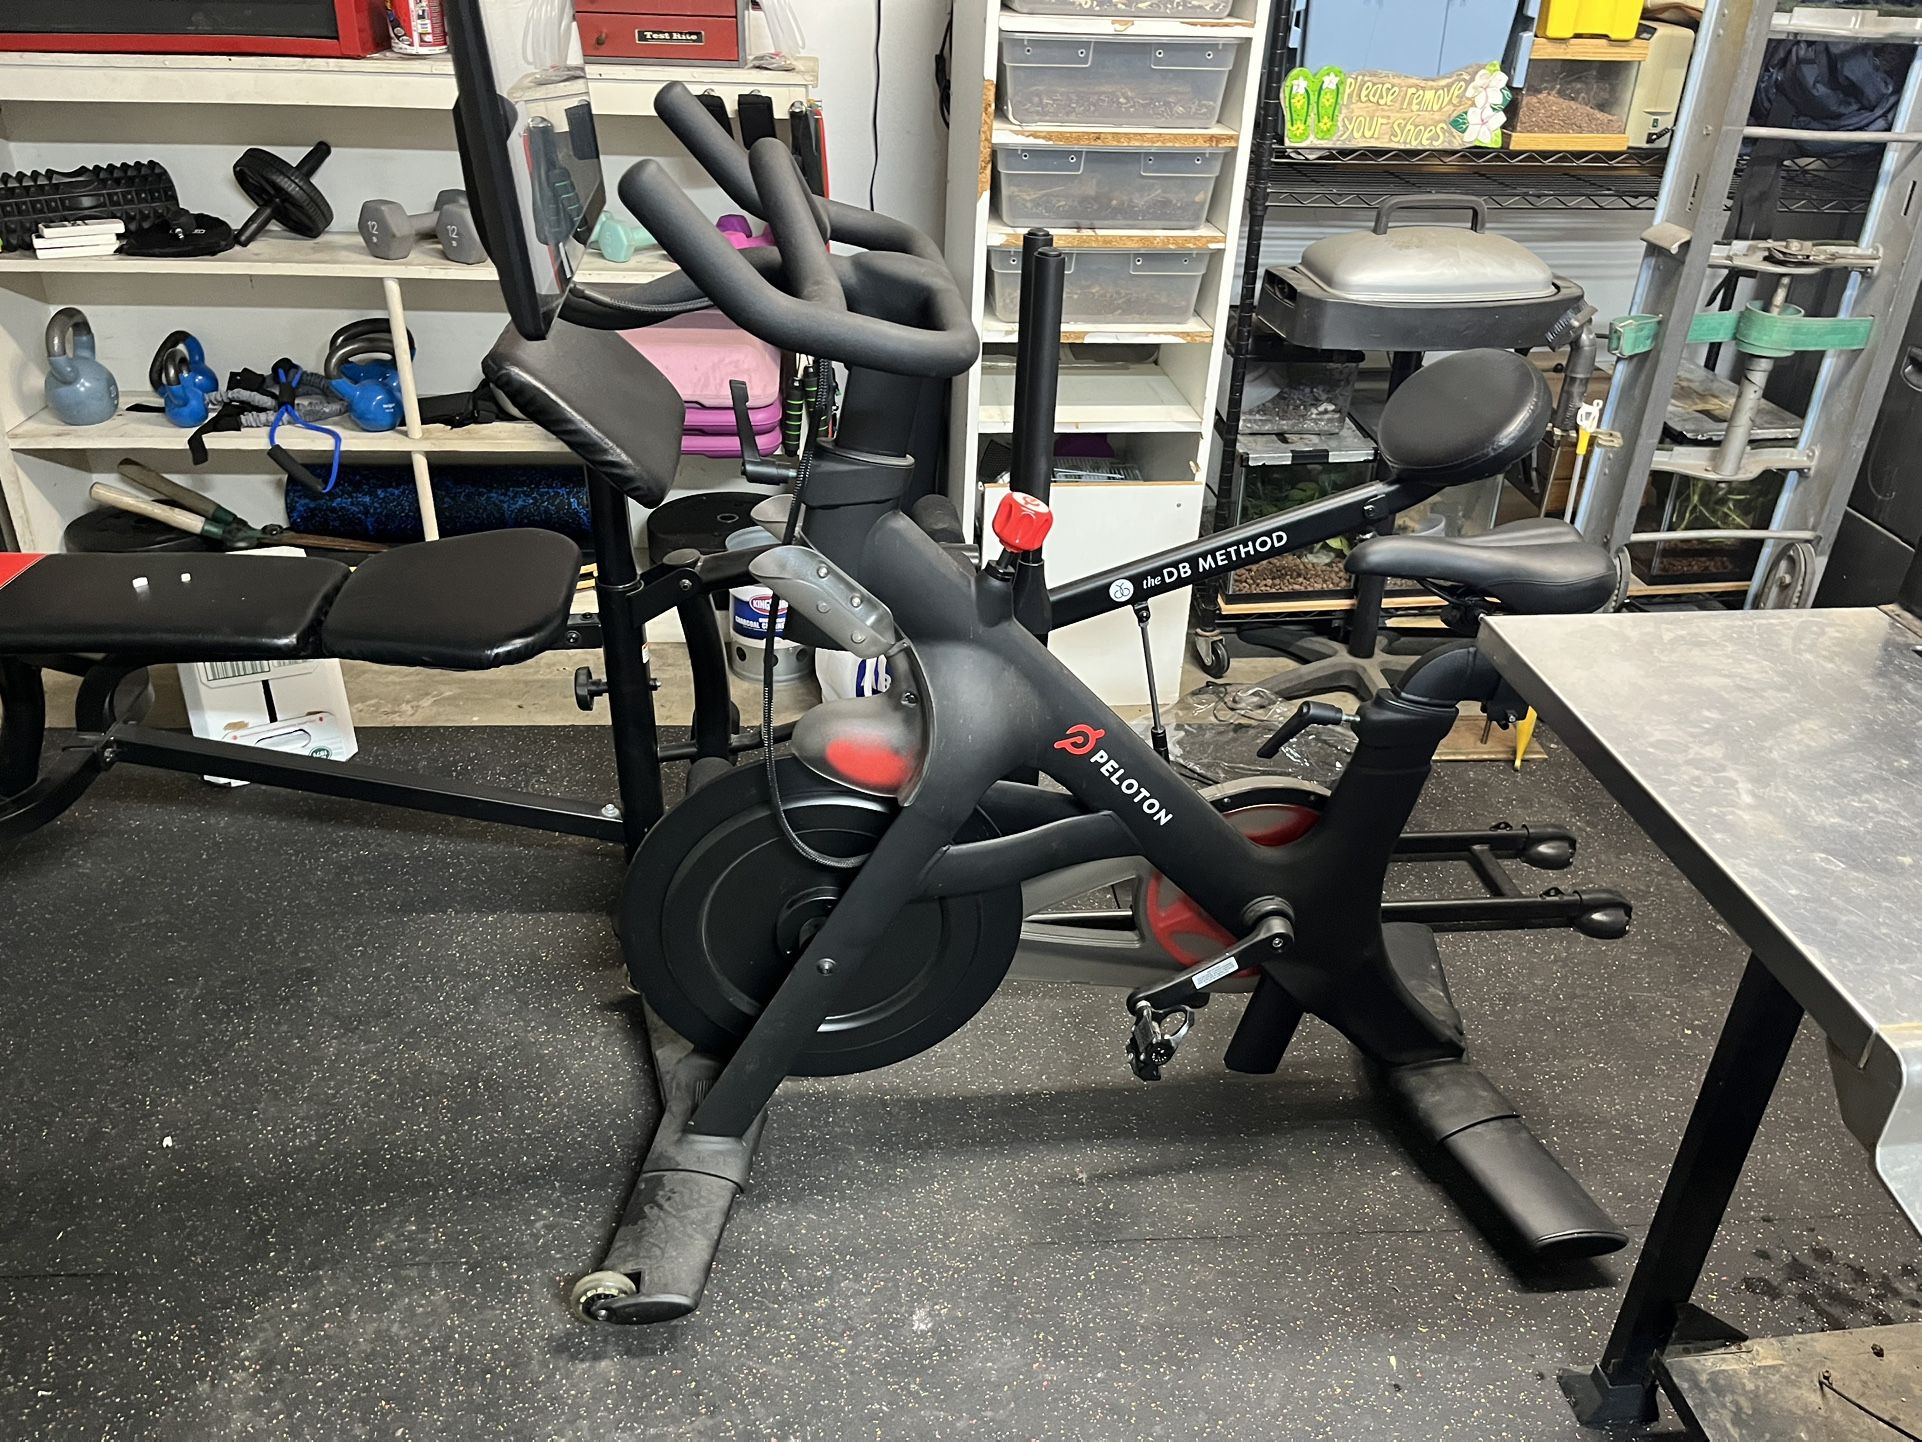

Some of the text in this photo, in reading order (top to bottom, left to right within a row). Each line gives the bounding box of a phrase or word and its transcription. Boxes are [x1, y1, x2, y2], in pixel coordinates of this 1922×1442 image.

[643, 31, 698, 40] Test Rite
[1343, 76, 1466, 112] Please remove
[1341, 114, 1449, 147] your shoes
[367, 220, 379, 234] 12
[446, 225, 459, 239] 12
[1142, 530, 1289, 590] the DB METHOD
[1089, 749, 1174, 826] PELOTON
